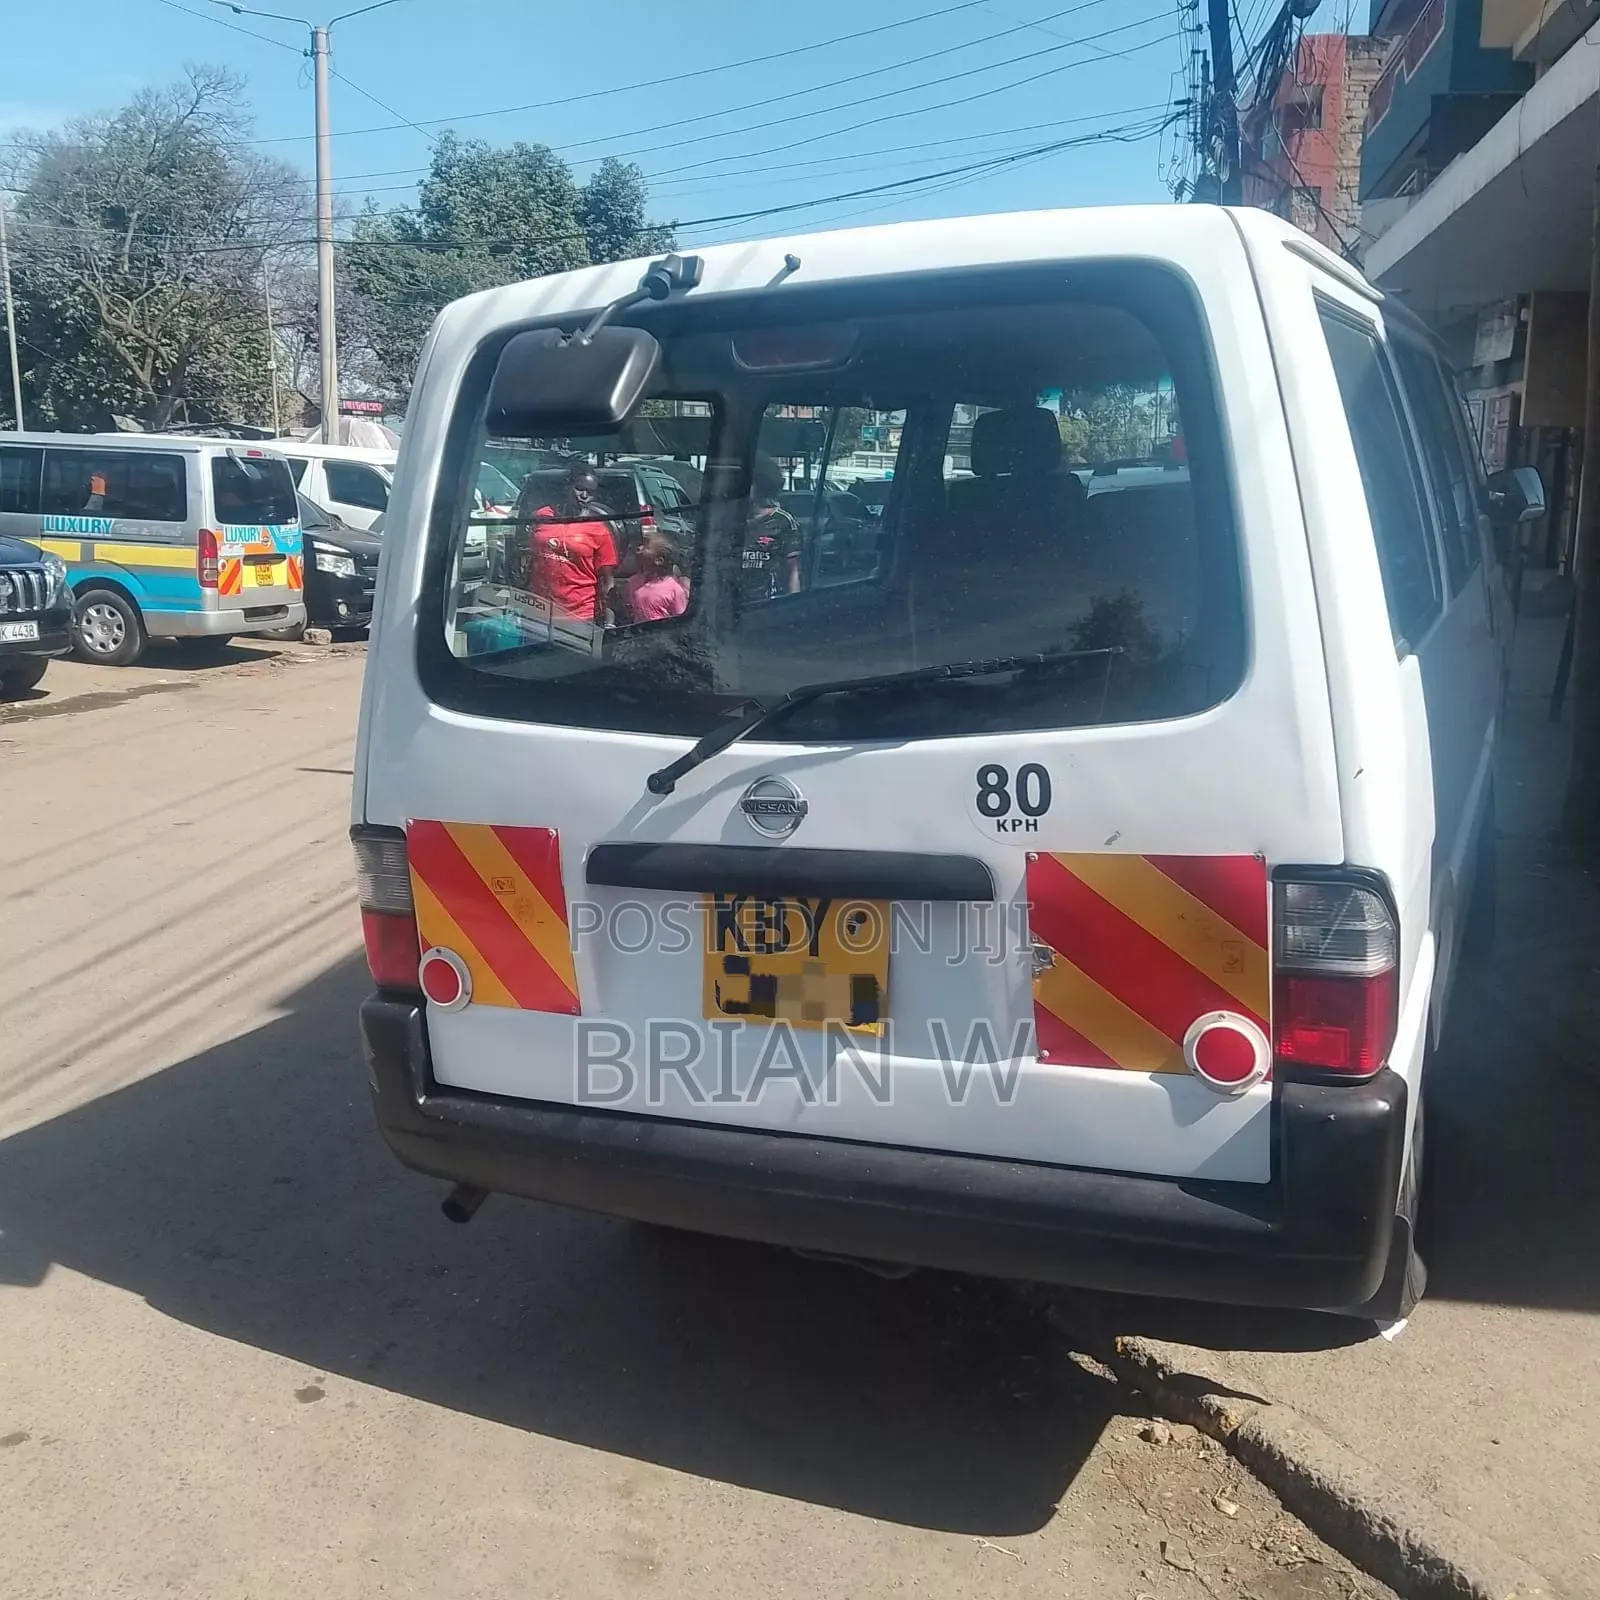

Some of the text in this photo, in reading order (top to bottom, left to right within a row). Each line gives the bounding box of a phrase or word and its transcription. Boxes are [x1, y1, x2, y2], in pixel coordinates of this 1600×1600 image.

[44, 515, 114, 536] LUXURY
[224, 526, 261, 543] LUXURY
[742, 549, 771, 560] irates
[976, 763, 1051, 817] 80
[743, 799, 800, 813] NISSAN
[996, 818, 1038, 832] KPH
[714, 893, 832, 957] KBY
